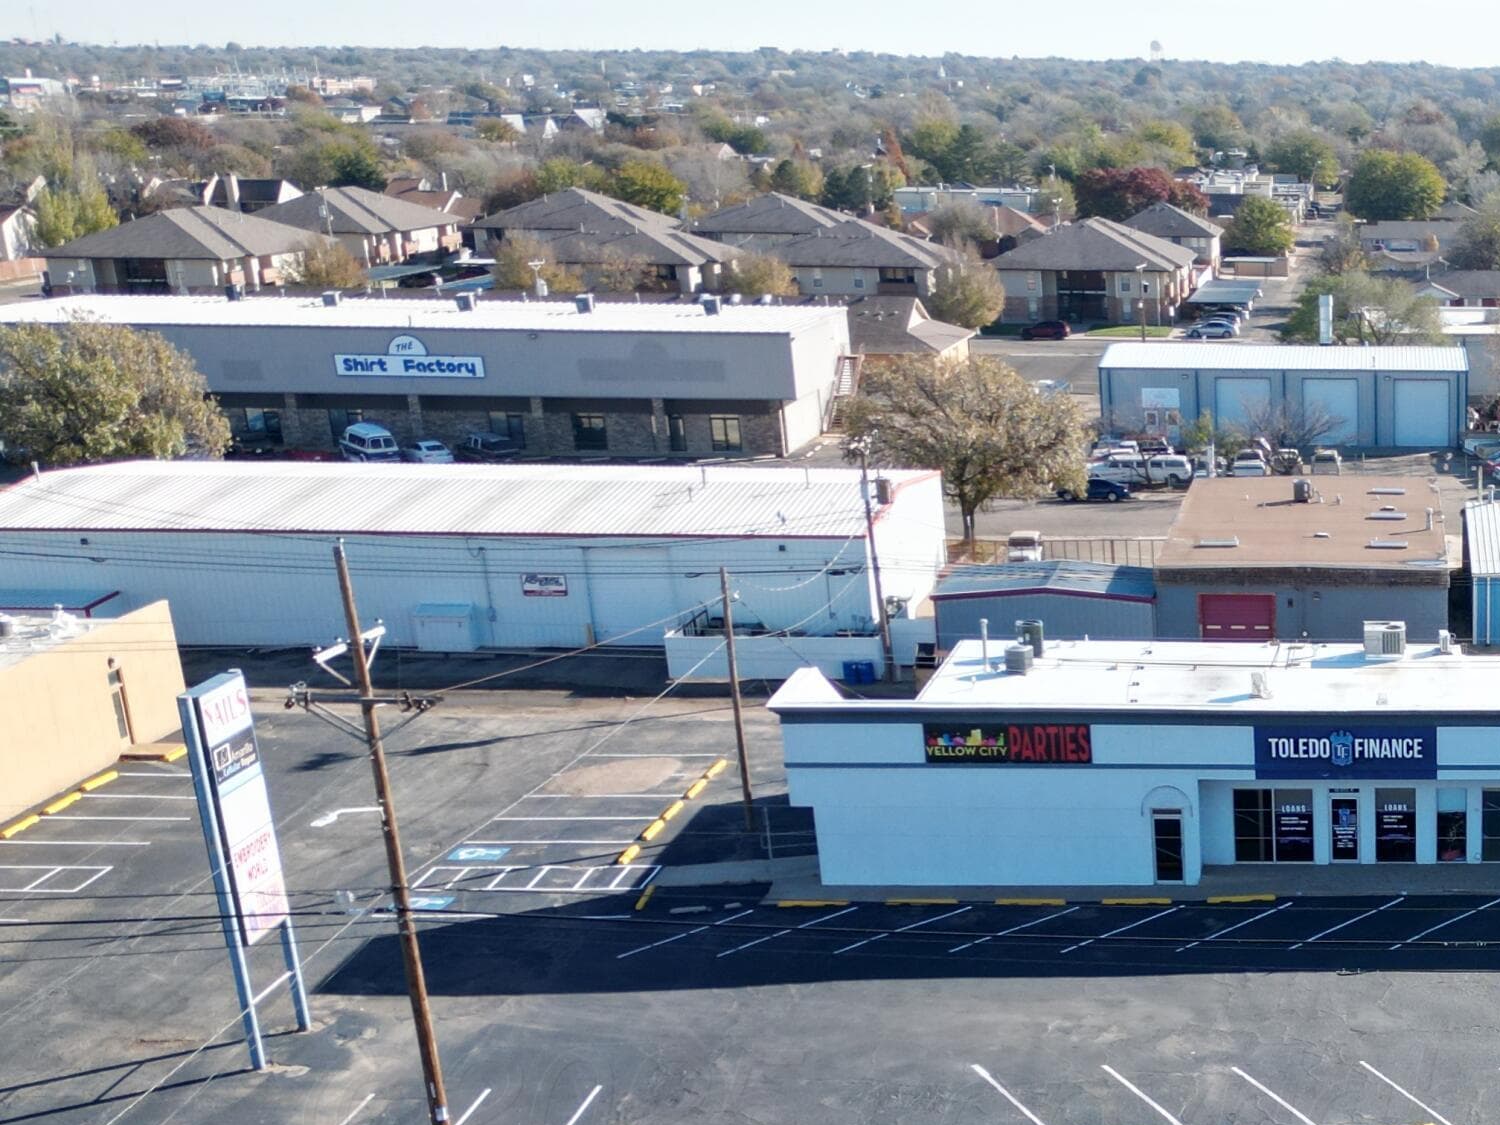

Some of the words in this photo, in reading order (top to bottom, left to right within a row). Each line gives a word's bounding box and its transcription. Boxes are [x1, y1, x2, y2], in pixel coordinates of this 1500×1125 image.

[396, 341, 413, 352] THE
[342, 358, 387, 372] Shirt
[403, 359, 477, 376] Factory
[204, 688, 248, 726] NAILS
[926, 746, 977, 757] YELLOW
[979, 746, 1008, 757] CITY
[1008, 725, 1090, 762] PARTIES
[1268, 738, 1330, 758] TOLEDO
[1355, 738, 1423, 759] FINANCE
